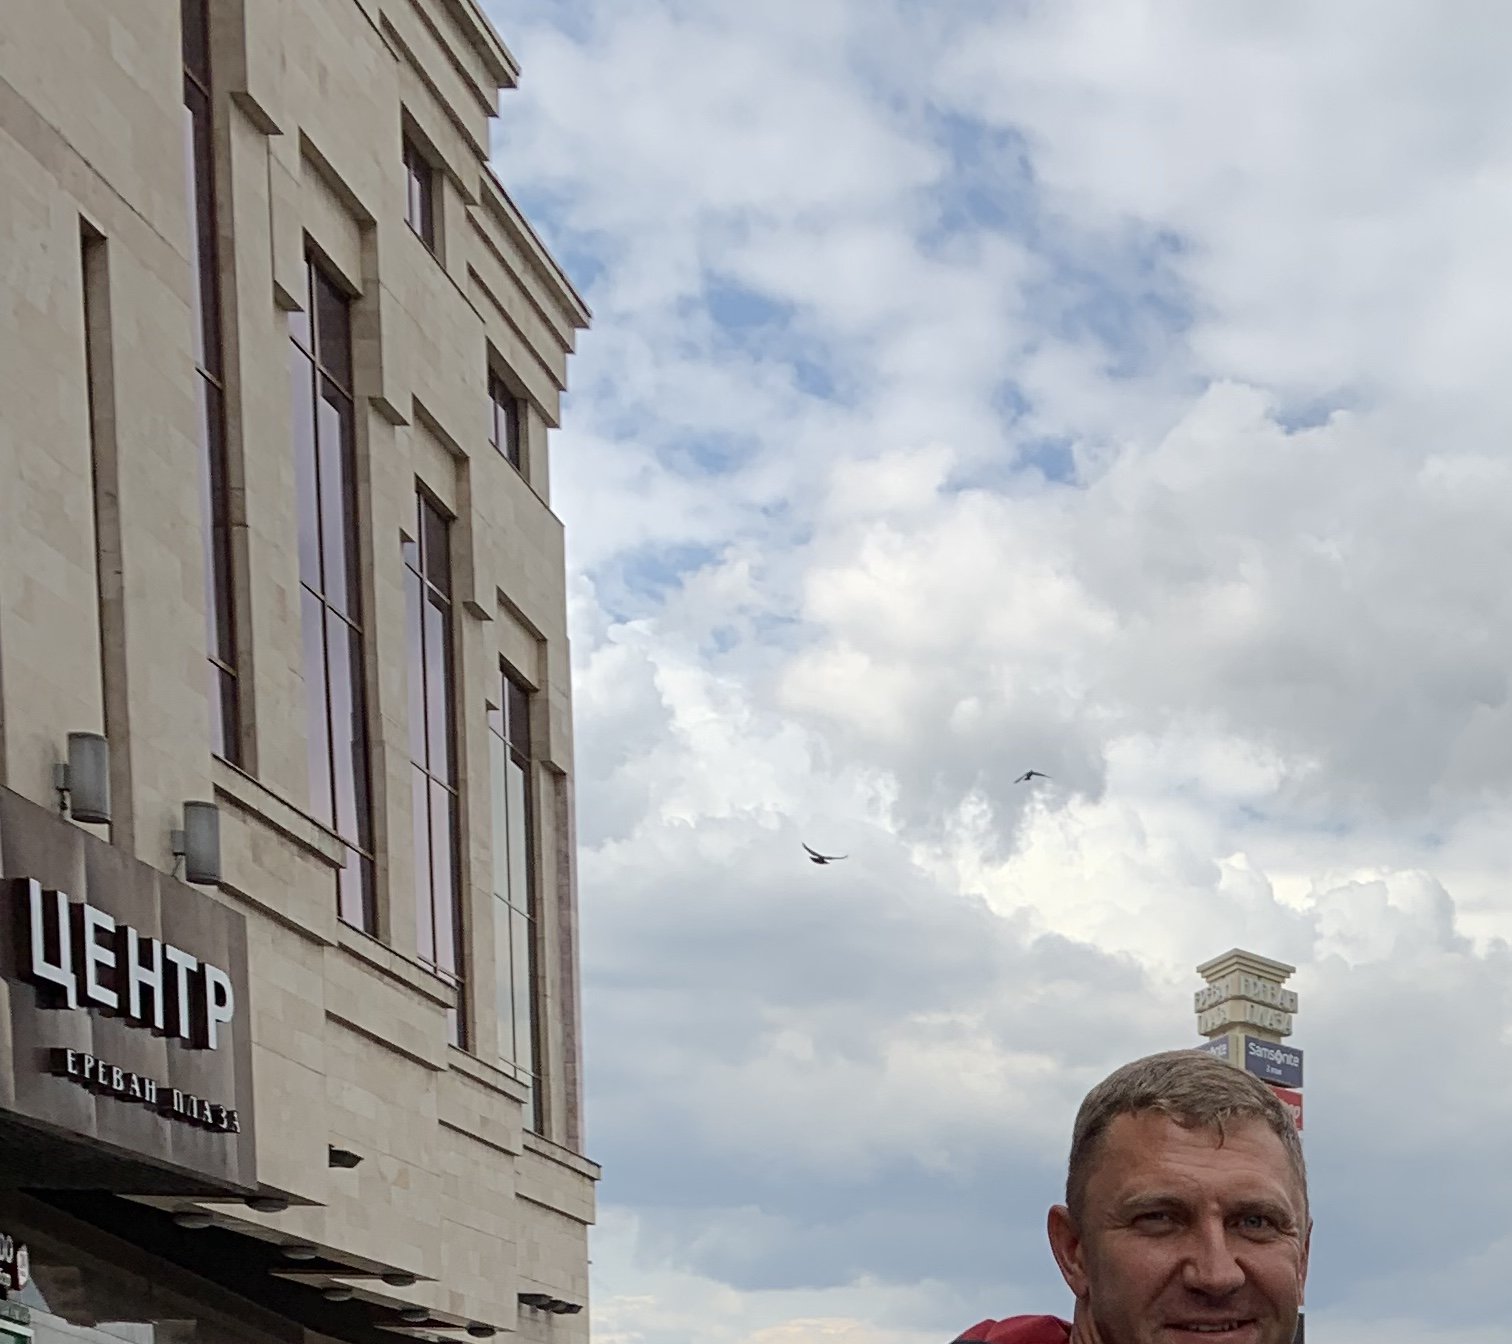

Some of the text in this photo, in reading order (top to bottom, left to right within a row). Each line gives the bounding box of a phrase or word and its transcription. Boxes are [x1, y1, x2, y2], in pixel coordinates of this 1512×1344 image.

[29, 877, 235, 1050] ЦЕНТР
[67, 1048, 241, 1134] ЕРЕВАН ПЛАЗА
[1248, 1042, 1300, 1068] Samsonite
